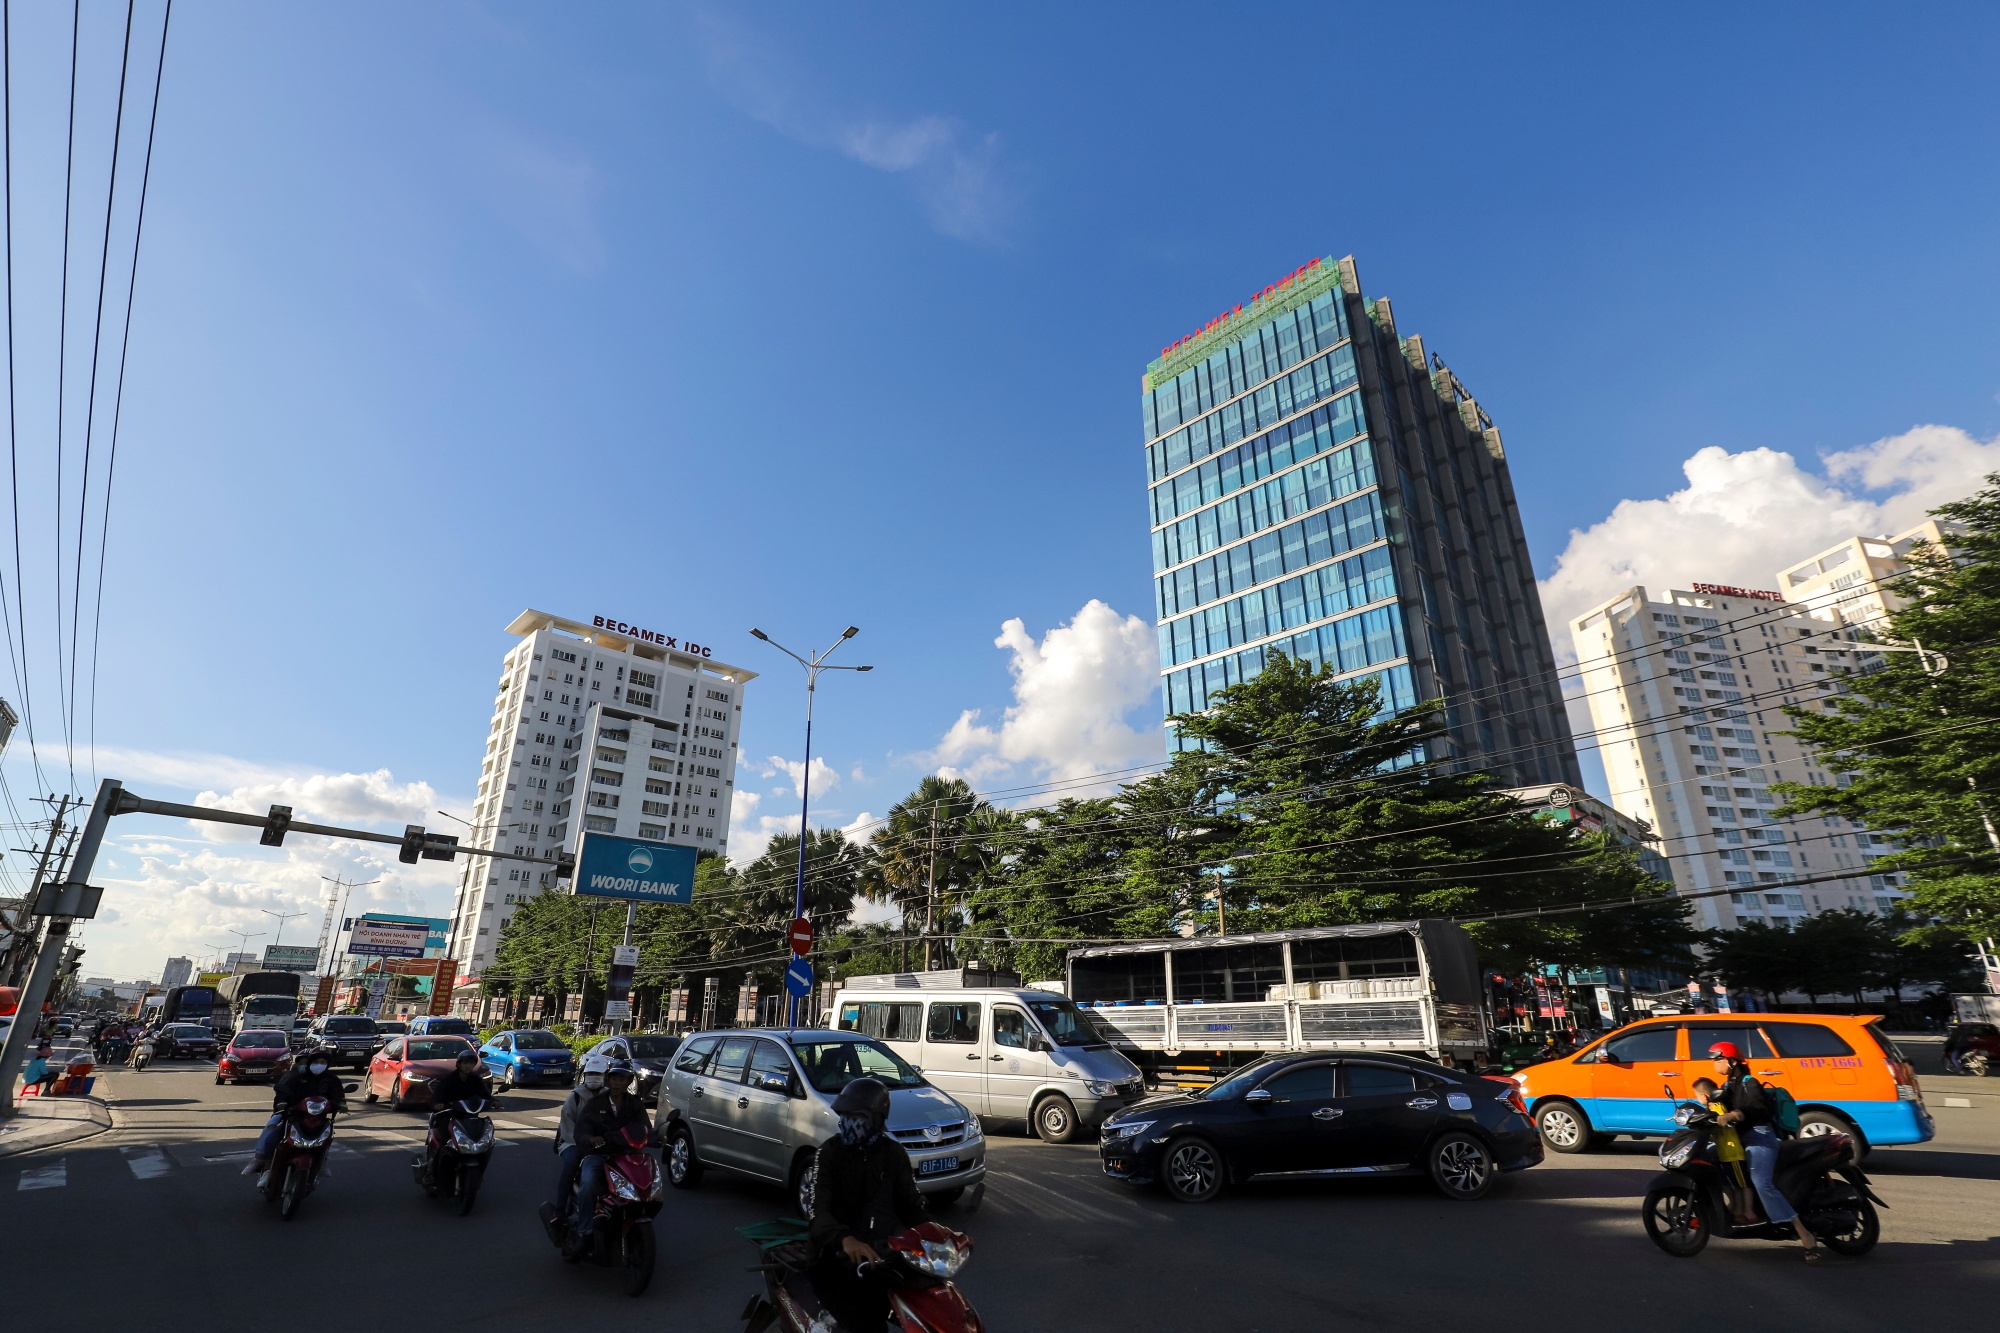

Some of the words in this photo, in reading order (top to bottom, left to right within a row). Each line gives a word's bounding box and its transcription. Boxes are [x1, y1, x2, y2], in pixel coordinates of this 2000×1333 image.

[1161, 302, 1243, 362] BECAMEX
[1250, 257, 1322, 308] TOWER
[1693, 582, 1748, 598] BECAMEX
[1749, 589, 1786, 602] HOTEL
[593, 615, 677, 648] BECAMEX
[684, 641, 712, 657] IDC
[590, 874, 639, 892] WOORI
[638, 880, 680, 896] BANK
[268, 947, 317, 957] PROTRADE
[1800, 1057, 1864, 1068] 61P-1661
[922, 1157, 957, 1172] 61F-1149
